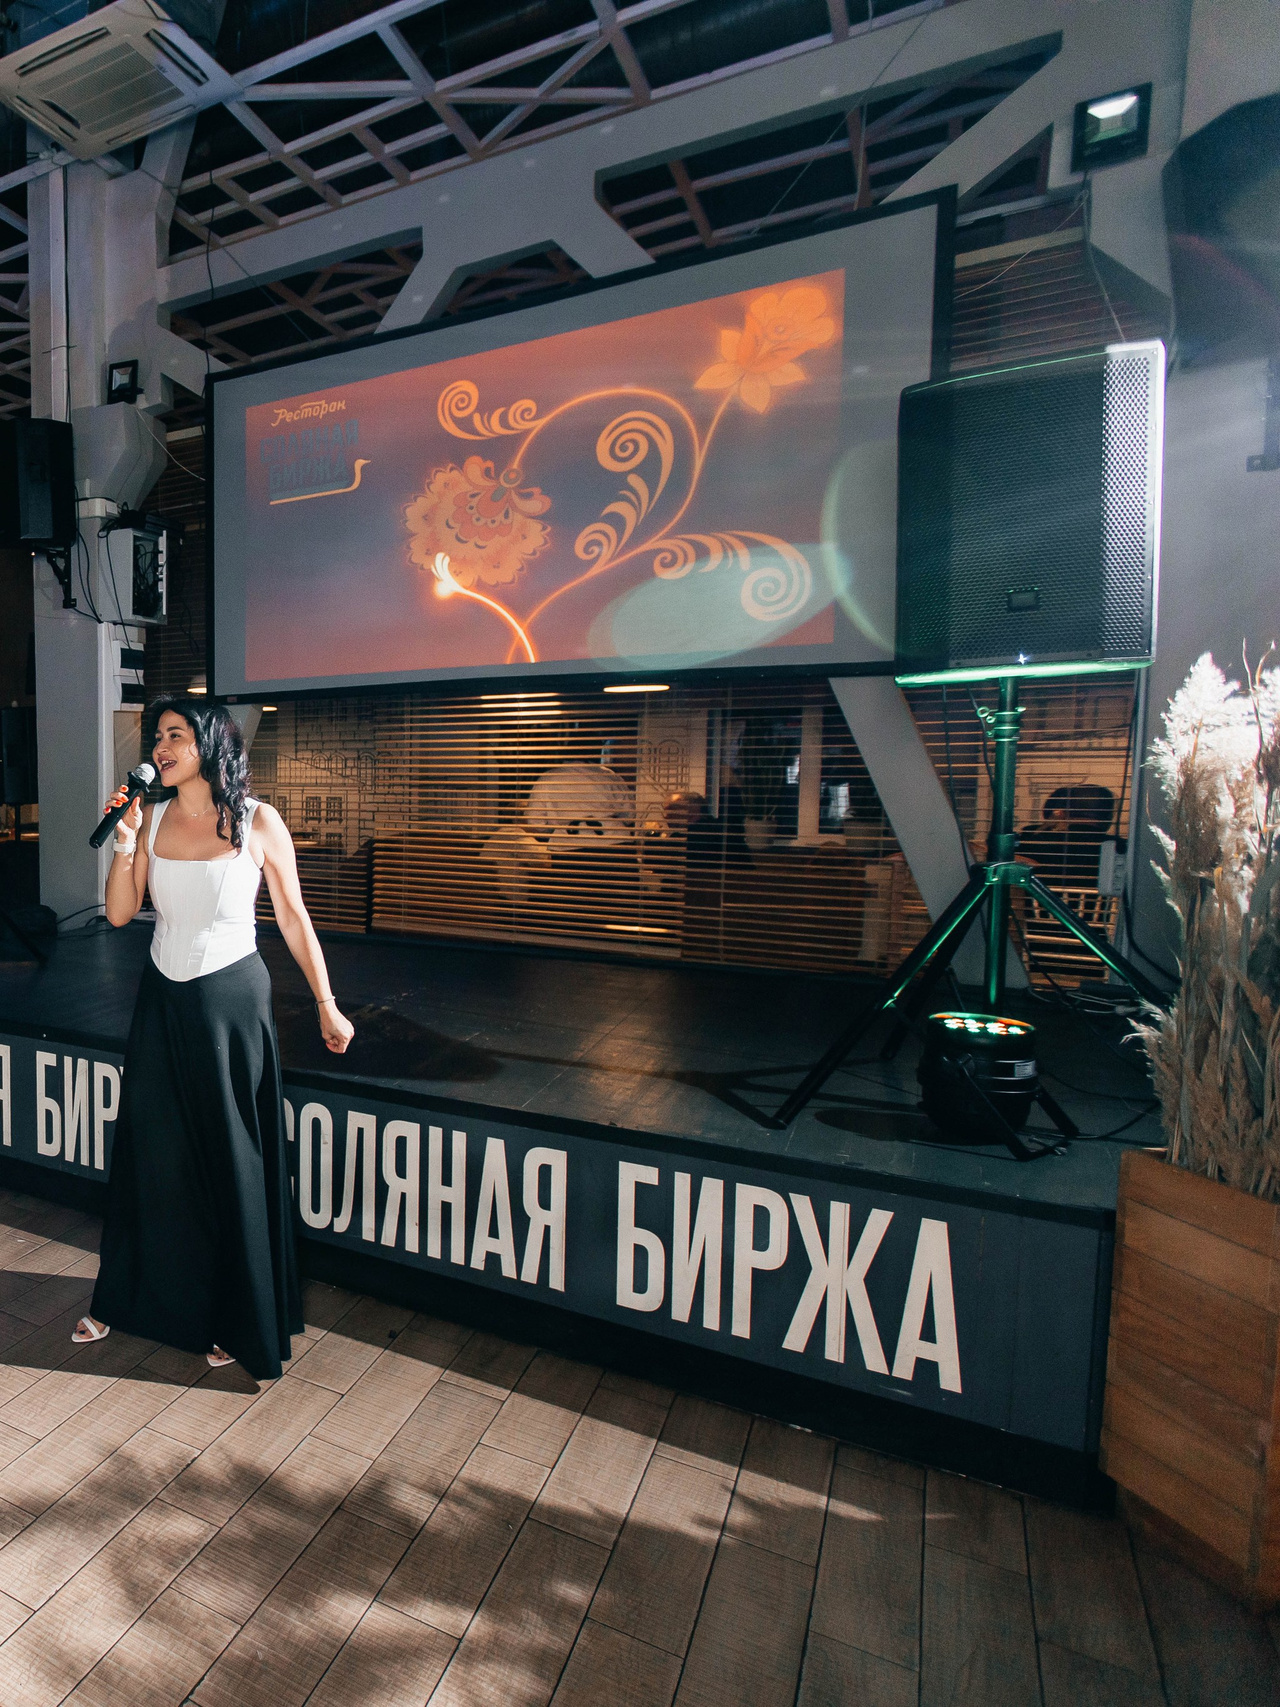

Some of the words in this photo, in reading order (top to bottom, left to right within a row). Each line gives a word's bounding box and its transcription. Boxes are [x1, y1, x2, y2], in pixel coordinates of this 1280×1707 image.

[261, 419, 359, 464] СОЛЯНАЯ
[271, 400, 346, 427] Ресторан
[36, 1051, 124, 1170] БИР
[616, 1161, 962, 1394] БИРЖА
